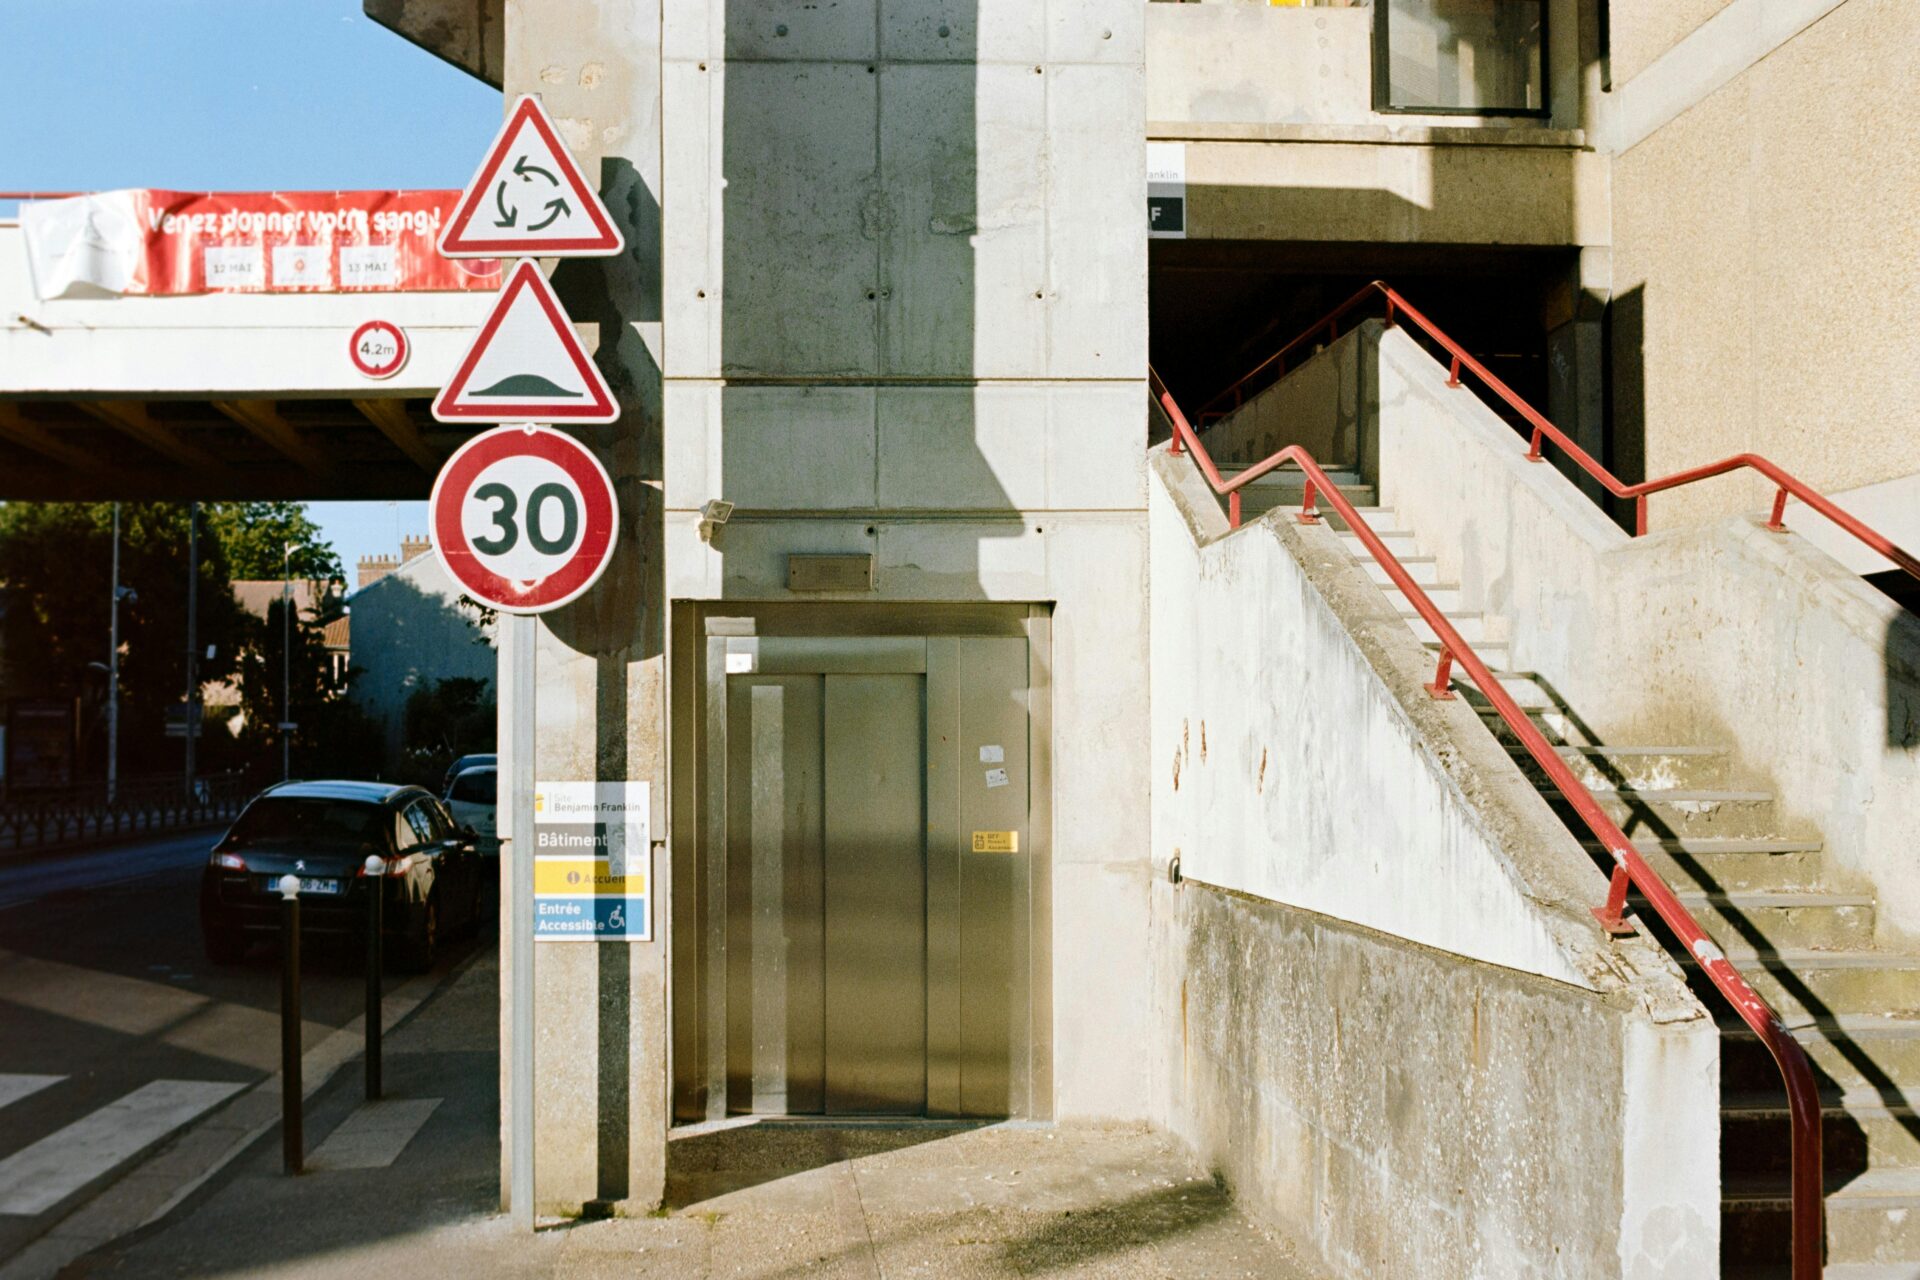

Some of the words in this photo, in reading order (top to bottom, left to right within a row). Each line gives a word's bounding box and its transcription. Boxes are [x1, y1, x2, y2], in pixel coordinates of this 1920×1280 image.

[1148, 169, 1178, 179] anklin
[1151, 207, 1161, 221] F
[148, 207, 217, 234] Venez
[221, 208, 305, 236] donner
[308, 208, 368, 231] votre
[213, 264, 226, 273] 12
[229, 263, 252, 273] MAI
[348, 263, 361, 272] 13
[365, 262, 388, 272] MAI
[360, 341, 395, 355] 4.2m
[472, 482, 578, 556] 30
[554, 802, 598, 814] Benjamin
[601, 802, 640, 812] Franklin
[538, 832, 608, 847] Bâtiment
[538, 903, 581, 915] Entrée
[538, 919, 605, 931] Accessible
